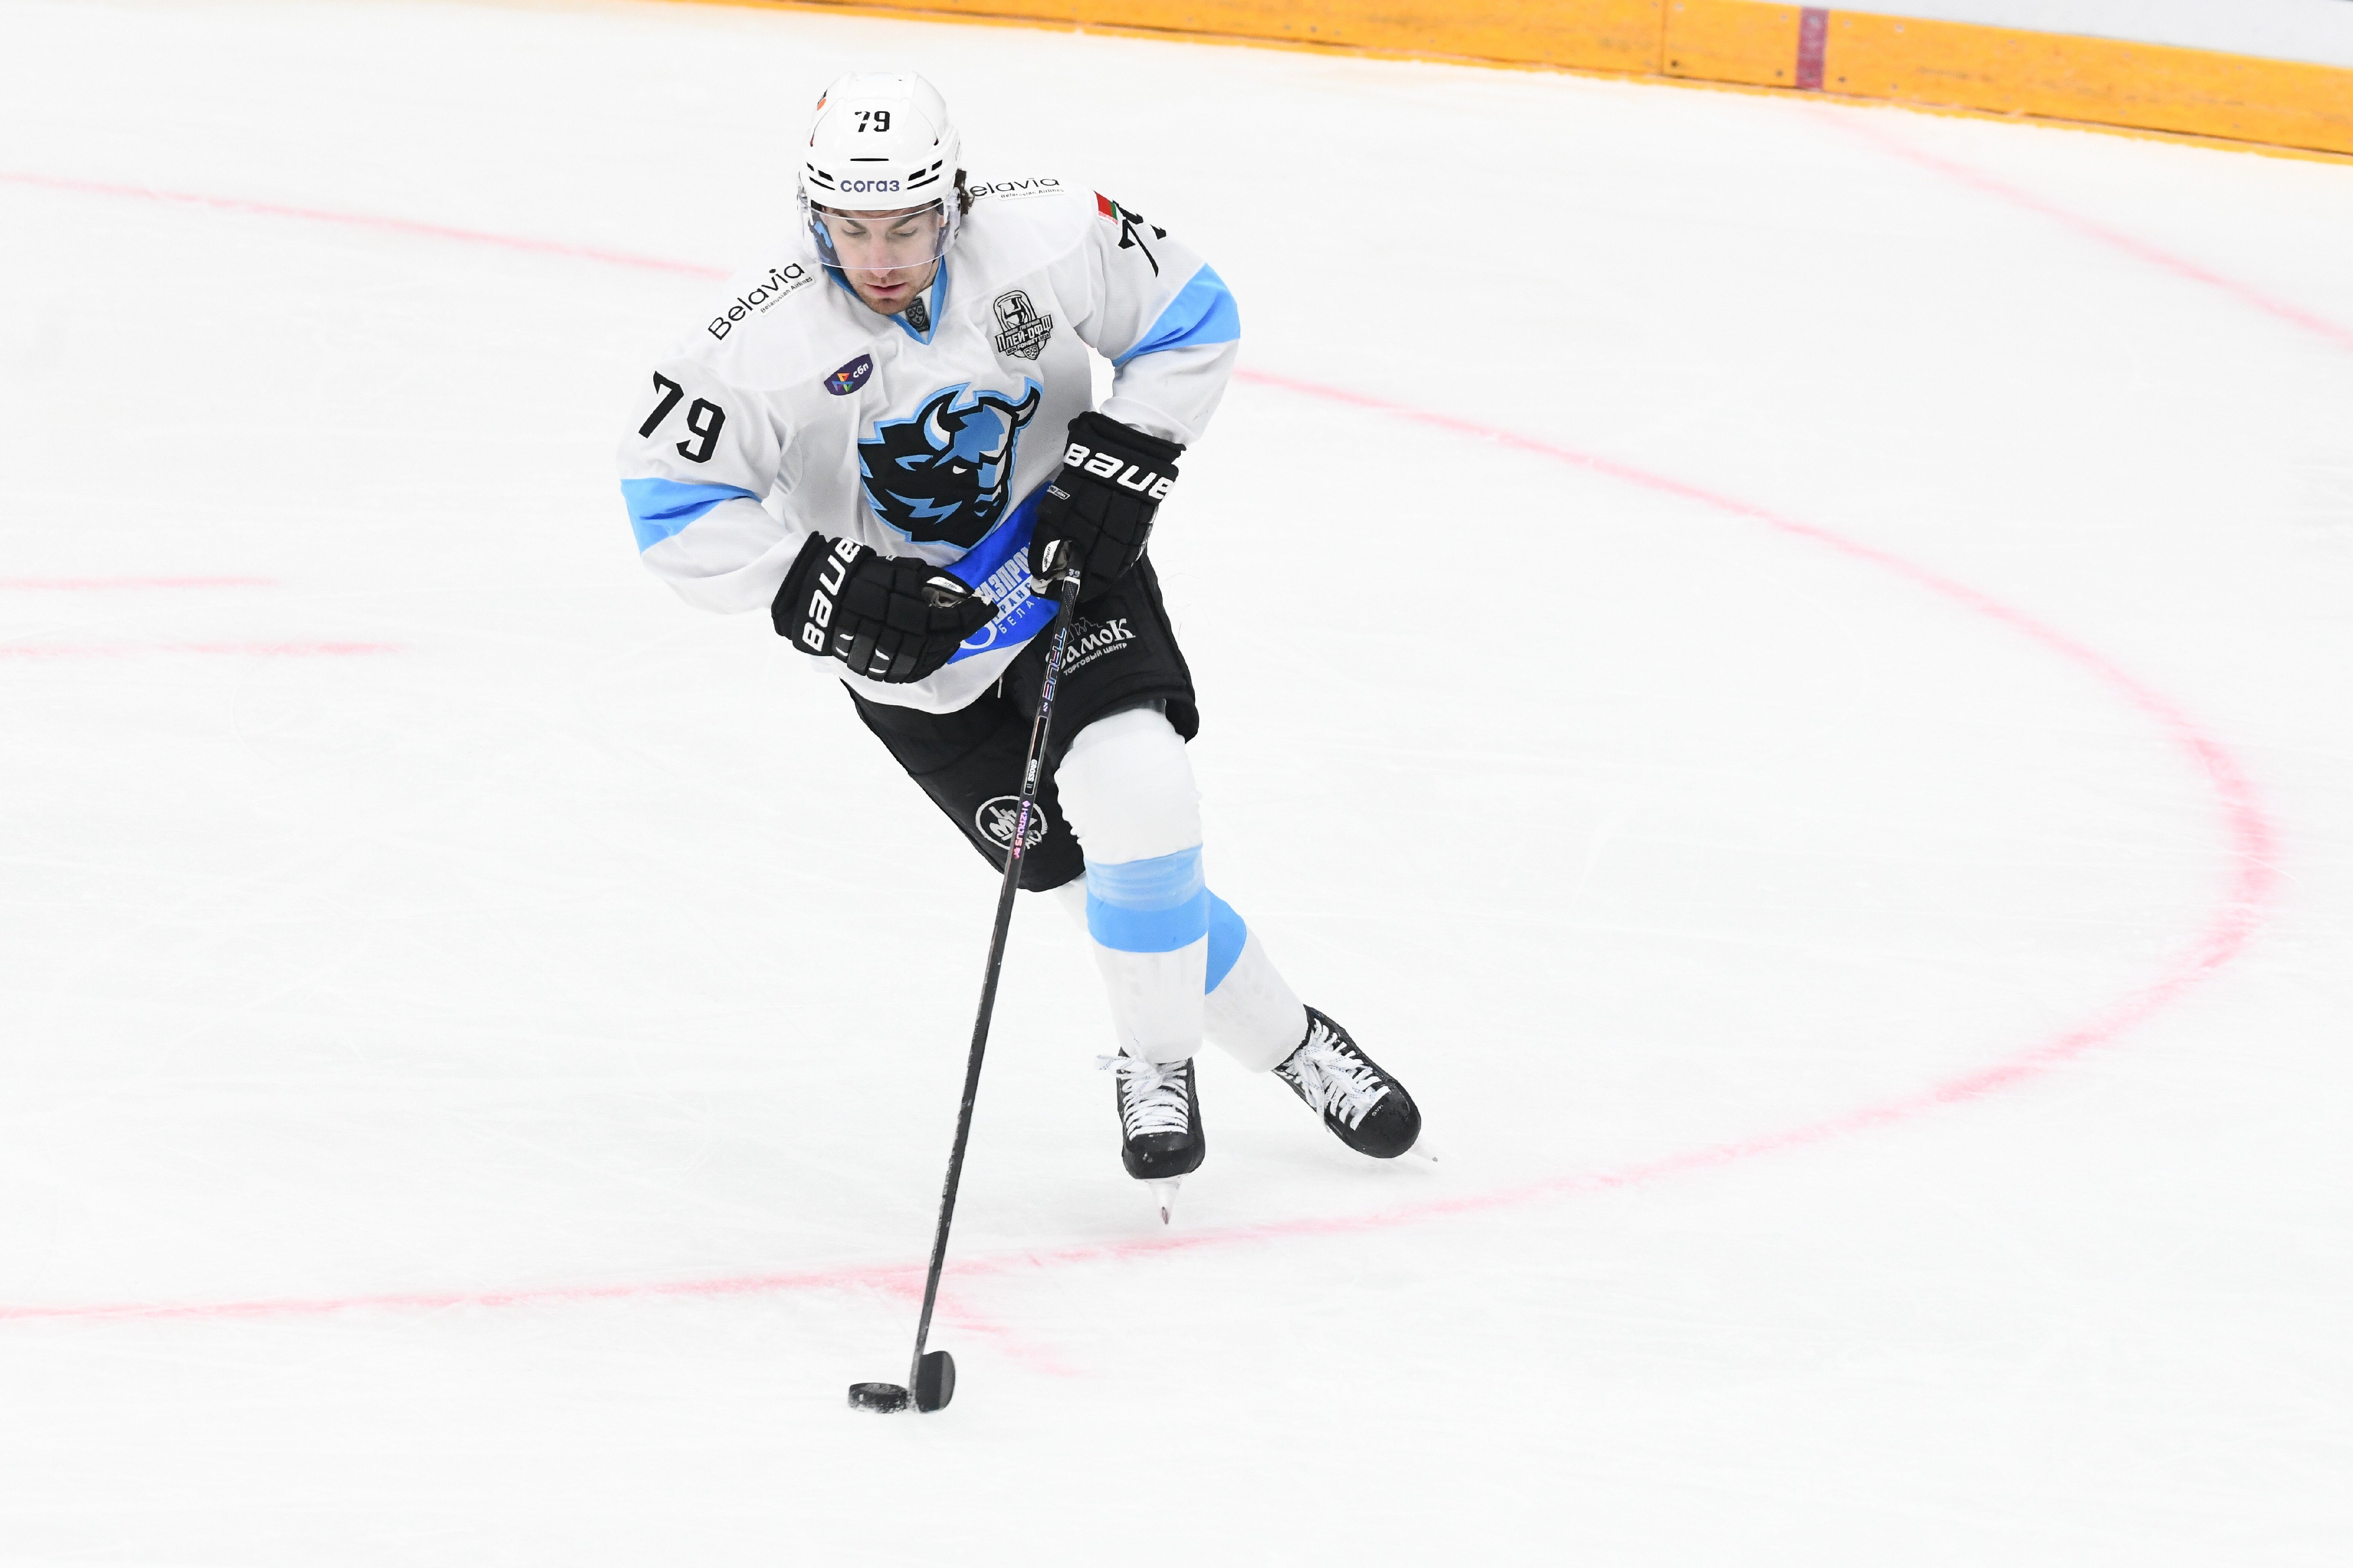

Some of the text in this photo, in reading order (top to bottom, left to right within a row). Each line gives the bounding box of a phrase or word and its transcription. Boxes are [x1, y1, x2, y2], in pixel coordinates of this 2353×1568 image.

[854, 111, 890, 132] 79
[840, 180, 900, 192] согаз
[969, 178, 1060, 196] elavia
[708, 263, 805, 340] Belavia
[760, 277, 813, 313] Belarusian Airlines
[997, 316, 1052, 352] ПЛЕЙ-ОФФ
[1017, 337, 1038, 349] FONBET
[638, 370, 726, 463] 79
[1063, 443, 1174, 500] BAUE
[802, 536, 864, 651] BAUE
[975, 547, 1031, 604] АЗПРО
[1042, 627, 1067, 701] TRUE
[1063, 643, 1127, 676] ТОРГОВЫЙ ЦЕНТР
[1028, 759, 1037, 782] GROSS
